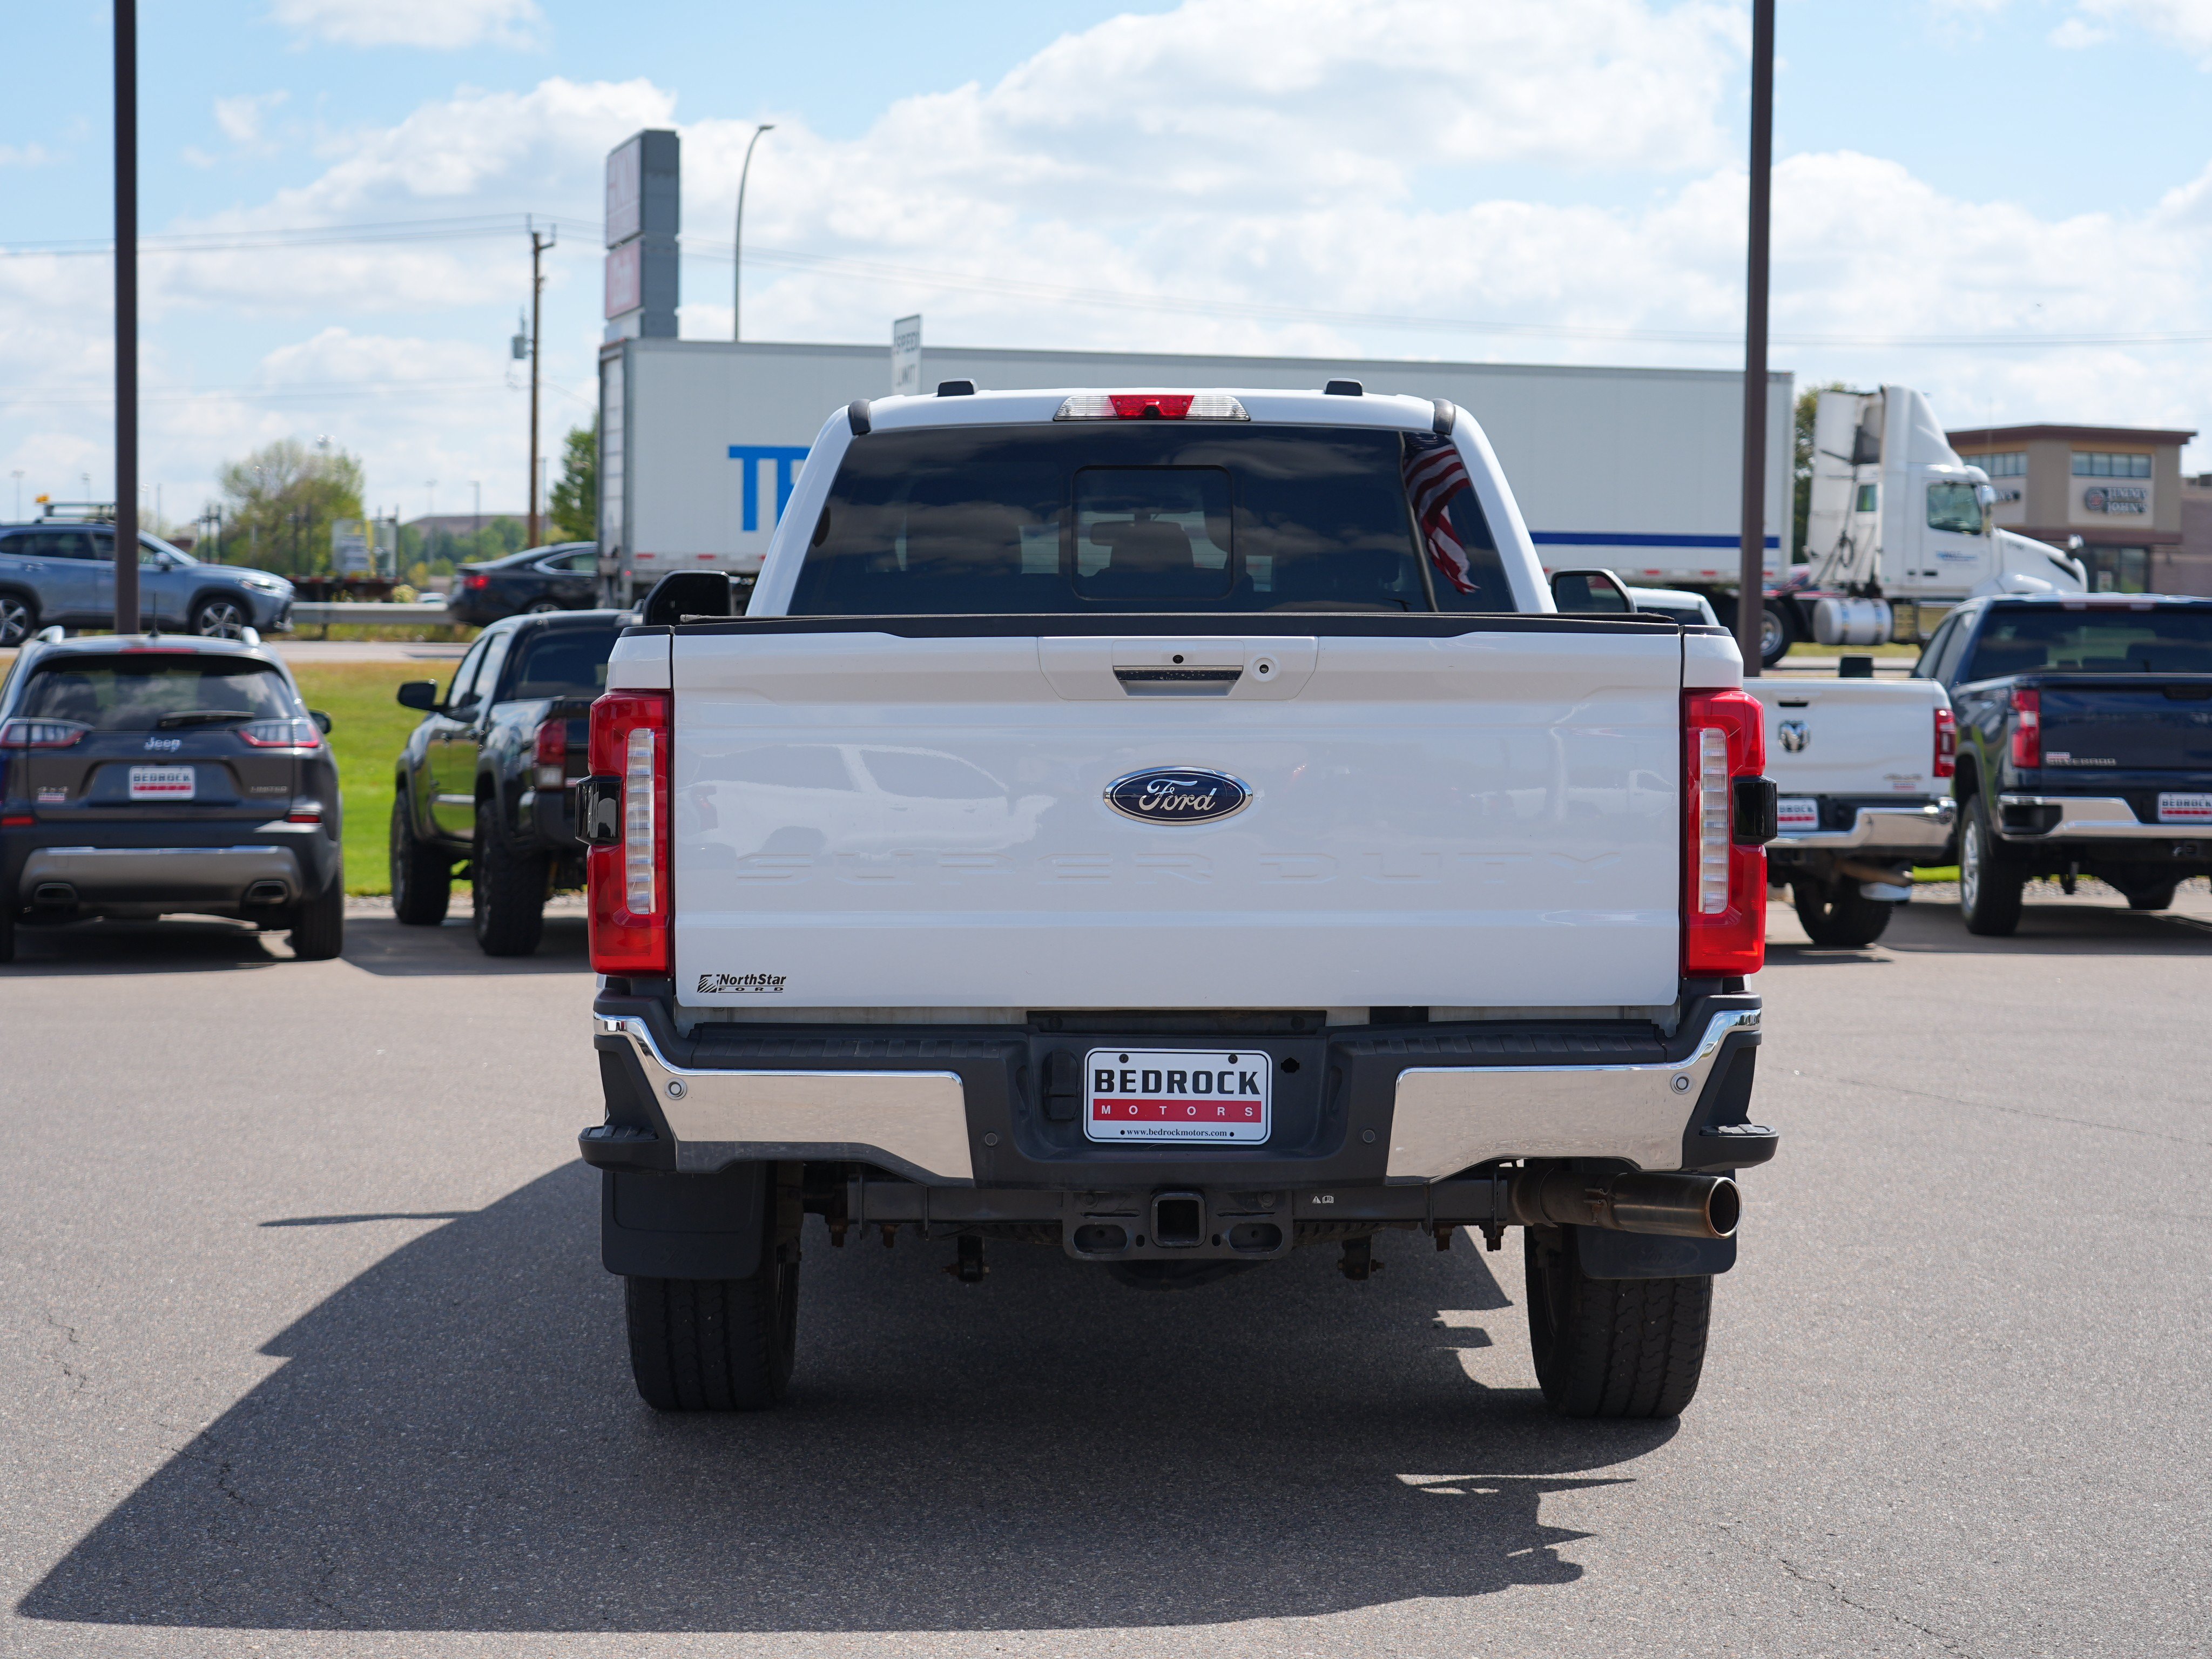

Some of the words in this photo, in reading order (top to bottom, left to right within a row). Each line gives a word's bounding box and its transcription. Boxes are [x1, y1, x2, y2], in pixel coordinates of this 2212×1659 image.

[897, 331, 919, 353] SPEED
[896, 363, 916, 386] LIMIT
[2107, 488, 2148, 501] JIMMY
[2107, 502, 2148, 512] JOHN'S
[144, 737, 181, 752] Jeep
[133, 773, 190, 781] BEDROCK
[1138, 779, 1217, 810] Ford
[736, 853, 1212, 885] SUPER
[1258, 852, 1622, 884] DUTY
[719, 974, 786, 984] NorthStar
[1094, 1069, 1260, 1095] BEDROCK
[1101, 1105, 1253, 1117] MOTORS
[1127, 1129, 1228, 1137] www.bedrockmotors.com
